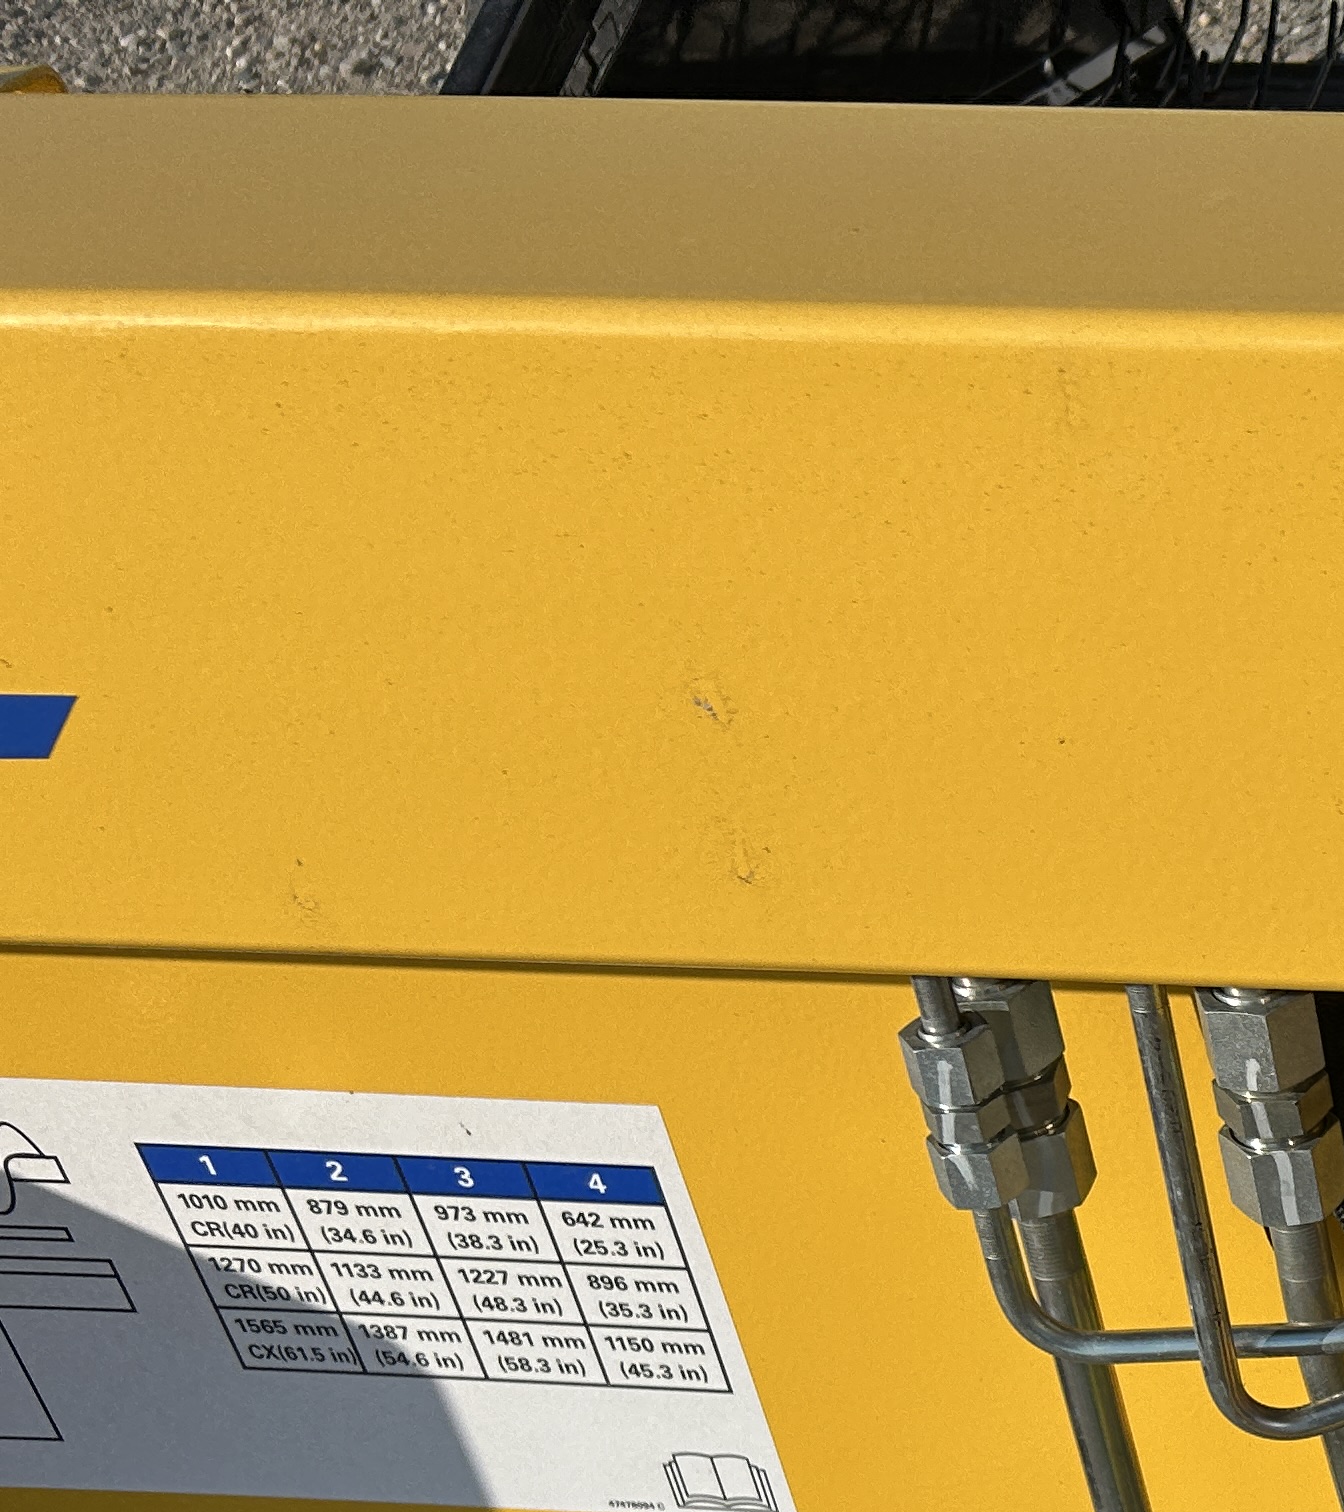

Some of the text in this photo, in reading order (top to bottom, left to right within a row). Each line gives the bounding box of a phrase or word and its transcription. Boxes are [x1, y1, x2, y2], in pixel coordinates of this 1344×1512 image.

[199, 1156, 608, 1194] 1 2 3 4
[177, 1193, 281, 1213] 1010 mm
[306, 1199, 402, 1219] 879 mm
[433, 1204, 529, 1225] 973 mm
[561, 1211, 656, 1231] 642 mm
[190, 1220, 295, 1243] CR(40 in)
[320, 1225, 413, 1248] (34.6 in)
[447, 1232, 539, 1254] (38.3 in)
[573, 1237, 664, 1261] (25.3 in)
[208, 1257, 314, 1276] 1270 mm
[330, 1262, 434, 1282] 1133 mm
[457, 1267, 563, 1288] 1227 mm
[586, 1274, 680, 1294] 896 mm
[224, 1284, 327, 1305] CR(50 in)
[350, 1288, 440, 1311] (44.6 in)
[472, 1294, 563, 1318] (48.3 in)
[599, 1300, 688, 1323] (35.3 in)
[234, 1318, 339, 1337] 1565 mm
[356, 1324, 462, 1344] 1387 mm
[482, 1329, 586, 1349] 1481 mm
[604, 1335, 706, 1356] 1150 mm
[248, 1344, 359, 1366] CX(61.5 in)
[375, 1349, 464, 1371] (54.6 in)
[498, 1354, 586, 1377] (58.3 in)
[620, 1361, 708, 1384] (45.3 in)
